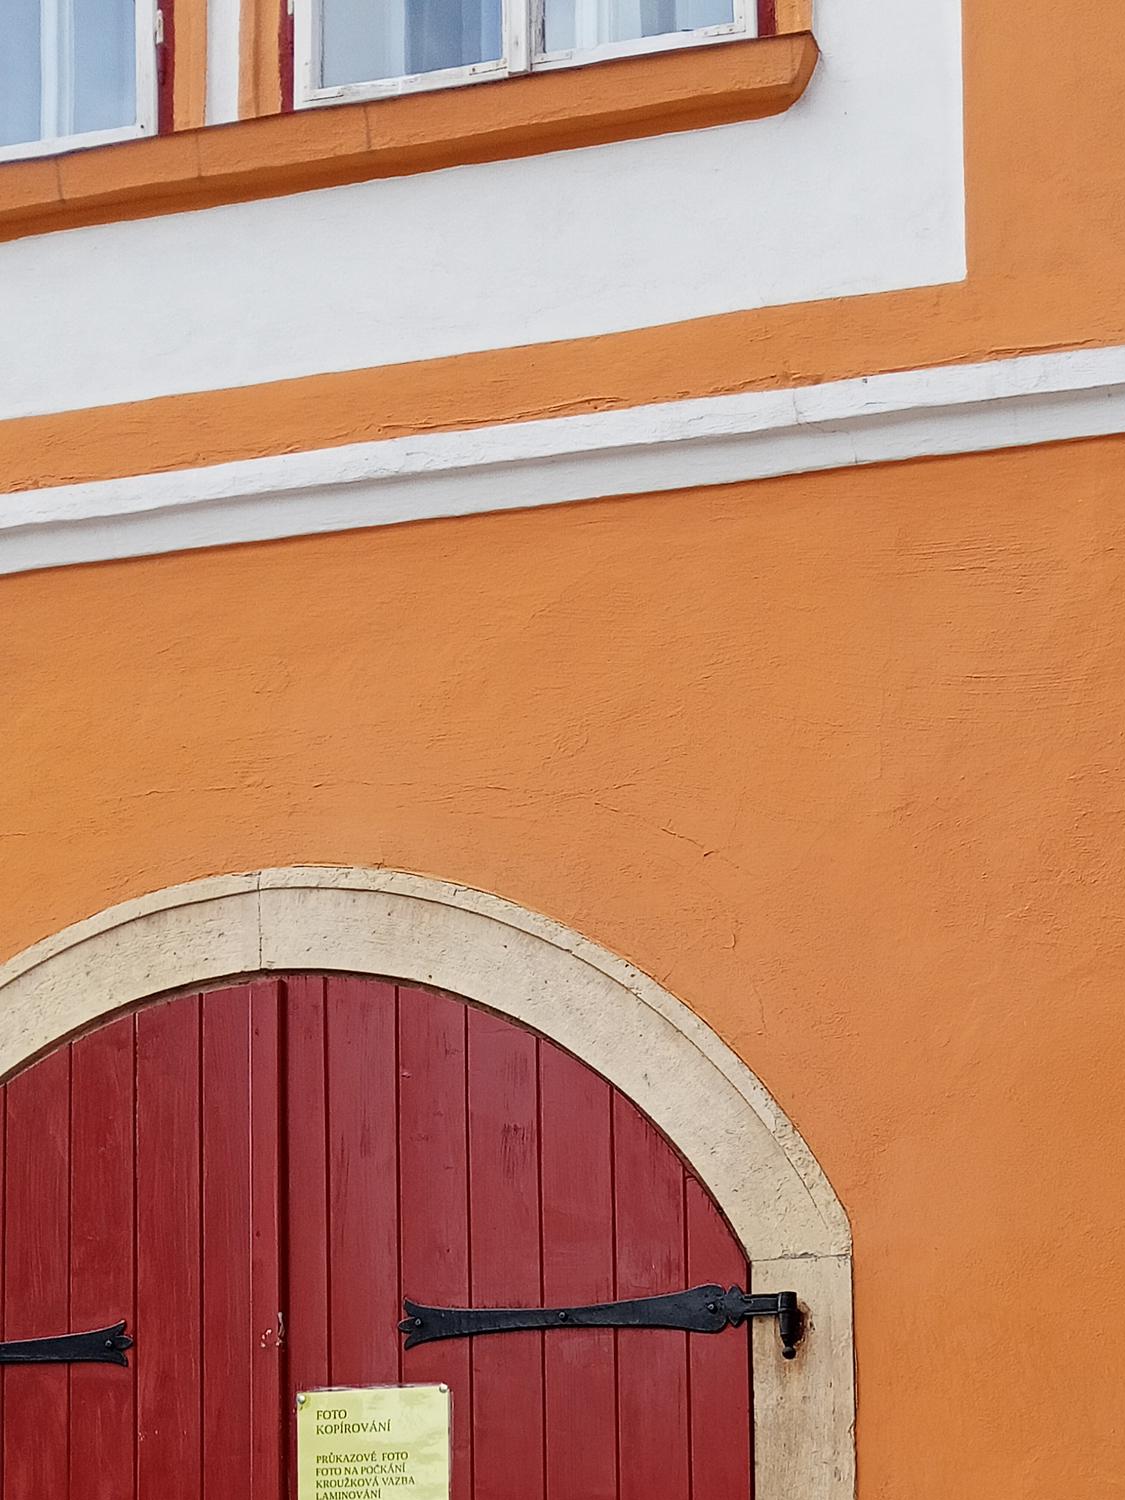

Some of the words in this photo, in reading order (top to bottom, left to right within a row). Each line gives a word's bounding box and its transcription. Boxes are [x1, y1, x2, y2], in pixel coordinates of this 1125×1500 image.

[316, 1409, 347, 1420] FOTO
[316, 1419, 391, 1435] KOPÍROVÁNÍ
[316, 1452, 377, 1464] PRŮKAZOVÉ
[382, 1451, 409, 1462] FOTO
[316, 1466, 342, 1476] FOTO
[344, 1466, 359, 1476] NA
[361, 1463, 406, 1474] POČKÁNÍ
[316, 1477, 379, 1489] KROUŽKOVÁ
[382, 1476, 415, 1486] VAZBA
[316, 1488, 381, 1500] LAMINOVÁNÍ
